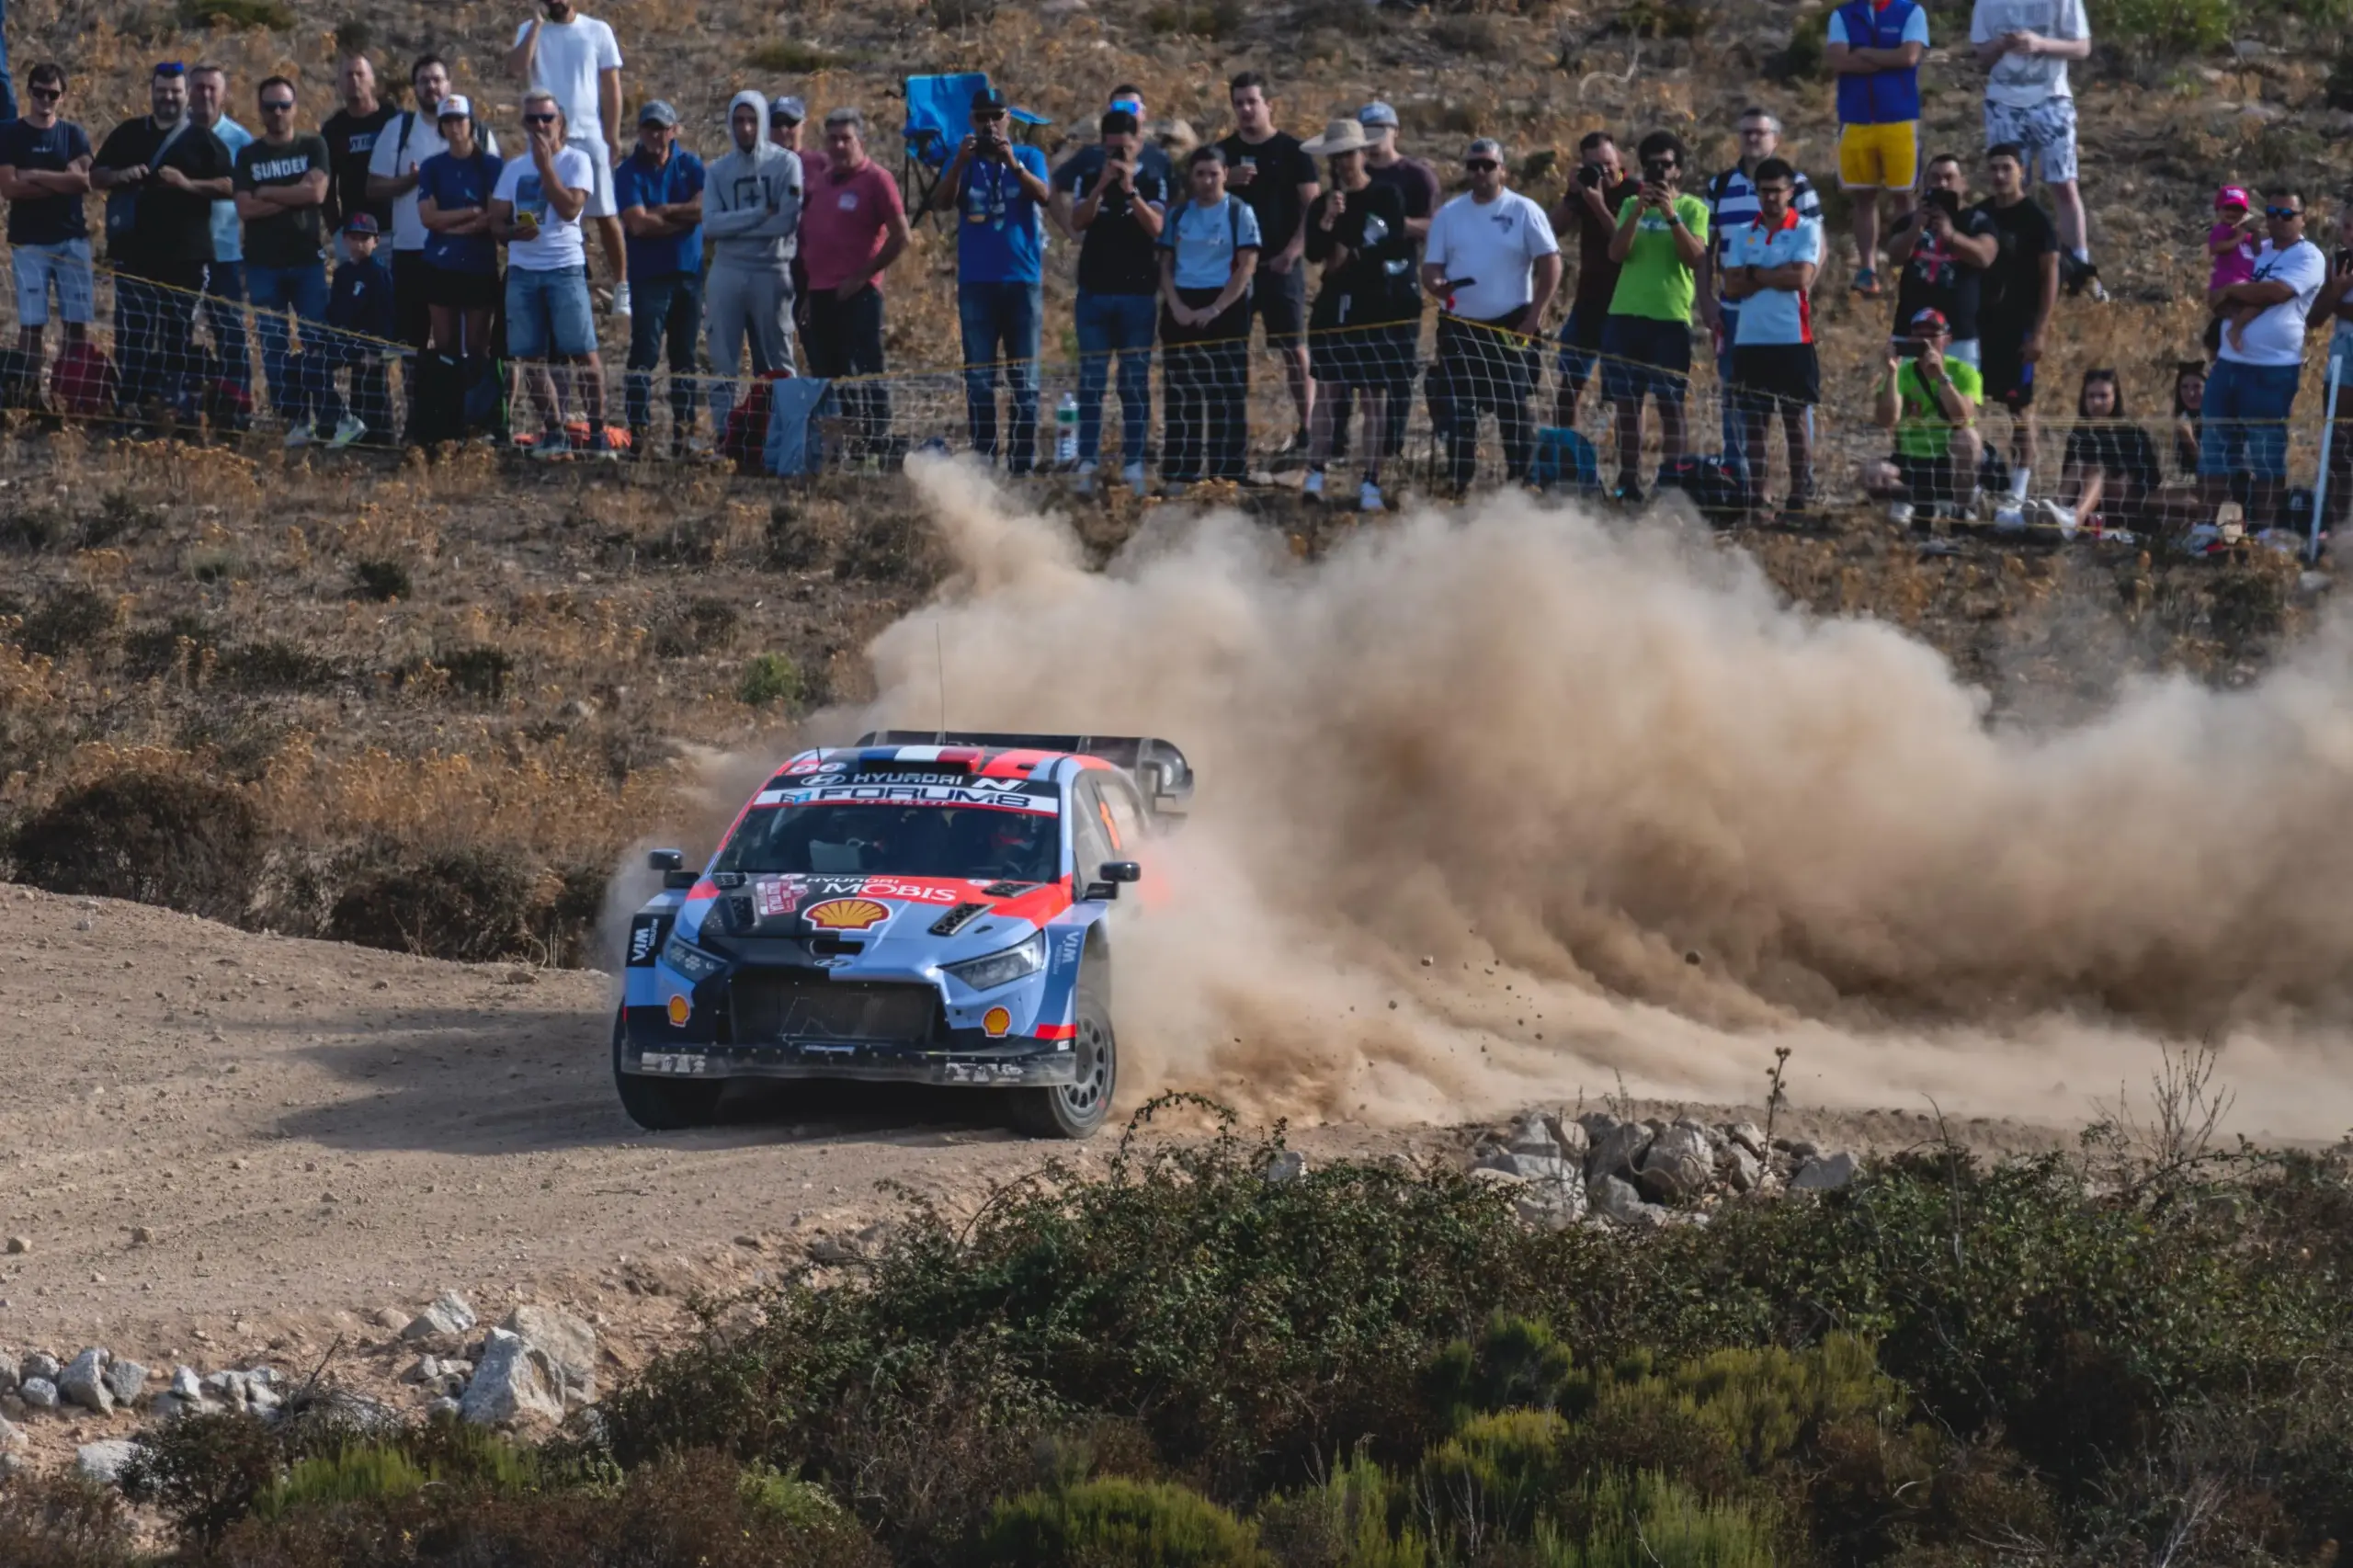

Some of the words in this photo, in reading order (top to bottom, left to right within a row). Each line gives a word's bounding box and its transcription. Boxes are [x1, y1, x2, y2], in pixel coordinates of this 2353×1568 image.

[853, 772, 962, 786] HYUNDAI
[818, 786, 1032, 809] FORUM8
[821, 882, 957, 902] MOBIS
